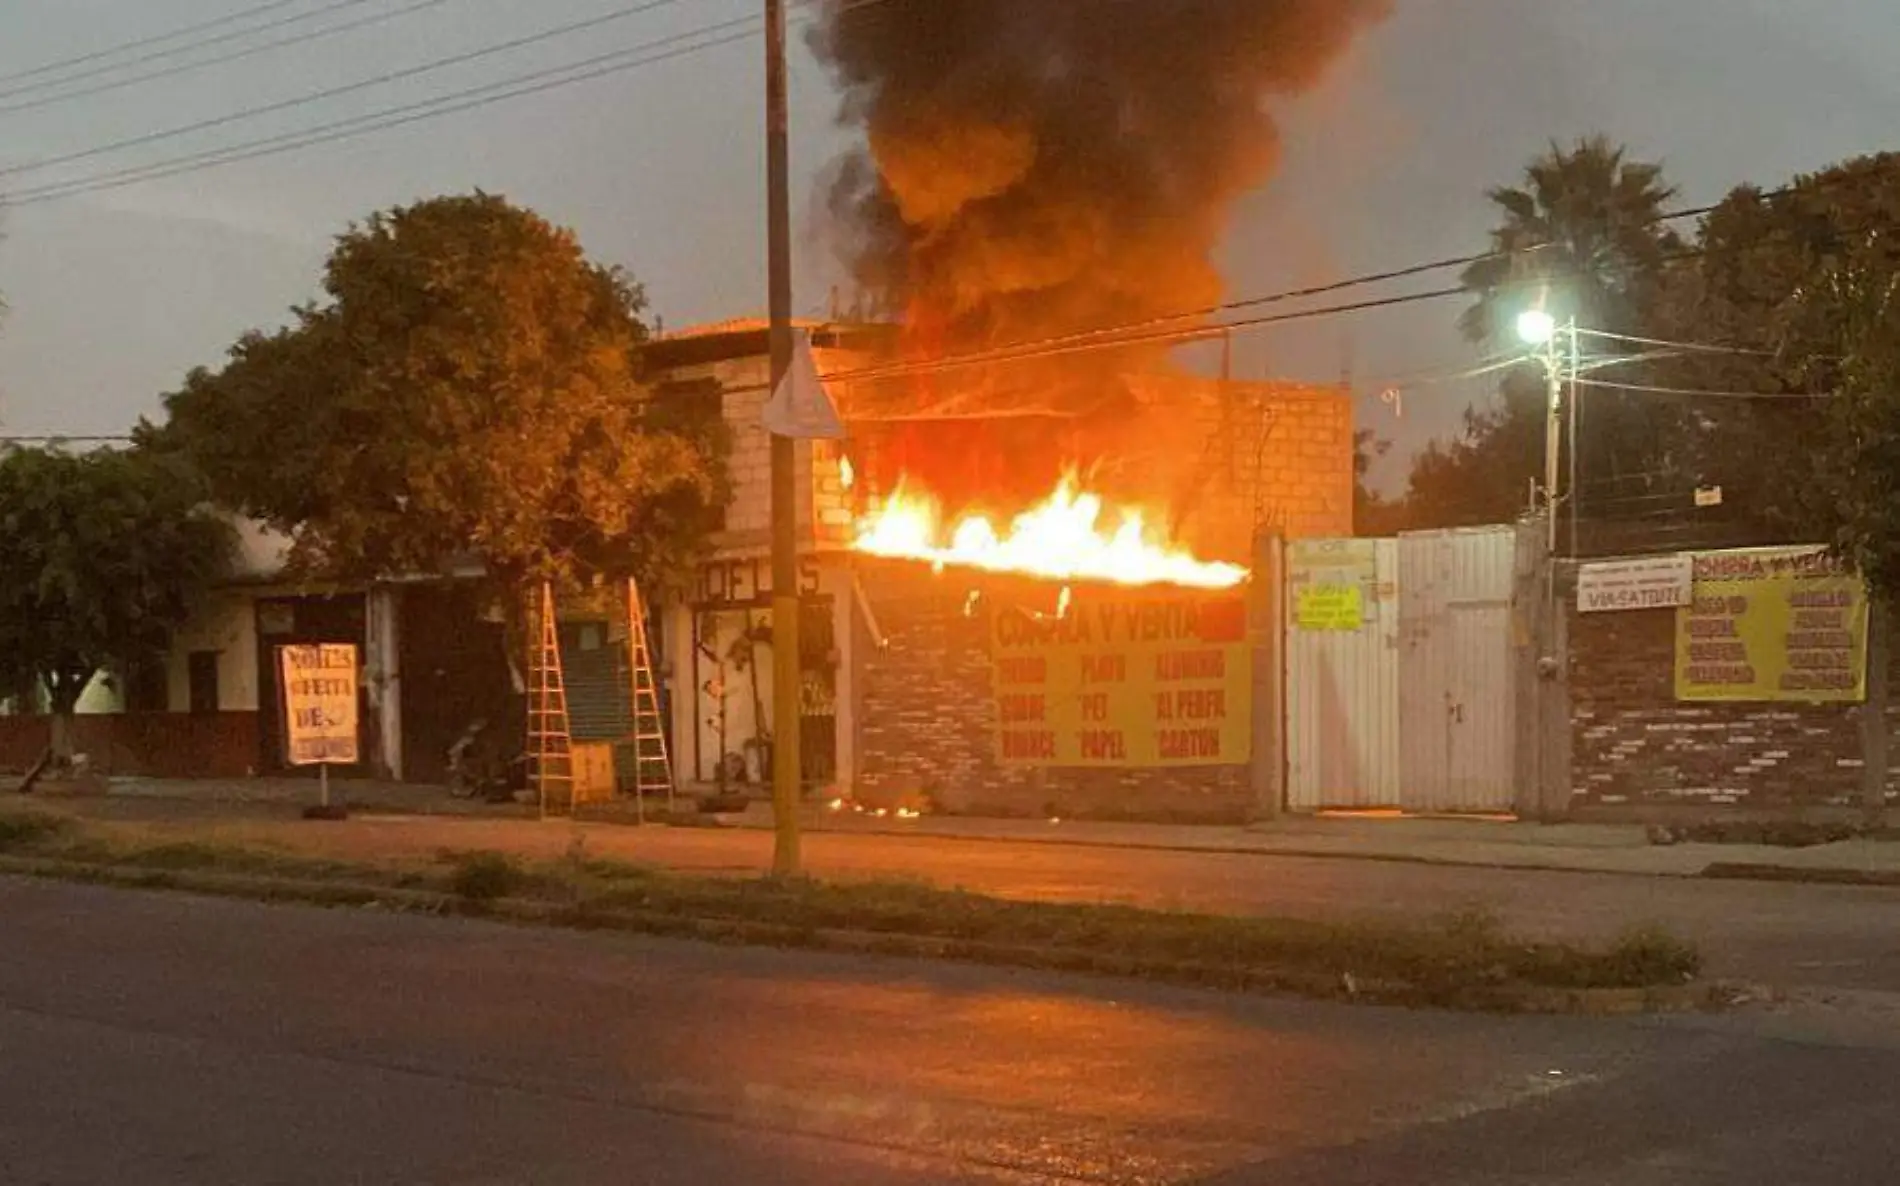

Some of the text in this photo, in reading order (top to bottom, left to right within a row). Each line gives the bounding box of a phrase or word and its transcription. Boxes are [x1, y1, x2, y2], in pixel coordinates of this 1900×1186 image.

[691, 554, 819, 600] OFLS
[1098, 602, 1115, 641] Y
[1081, 729, 1127, 760] PAPEL
